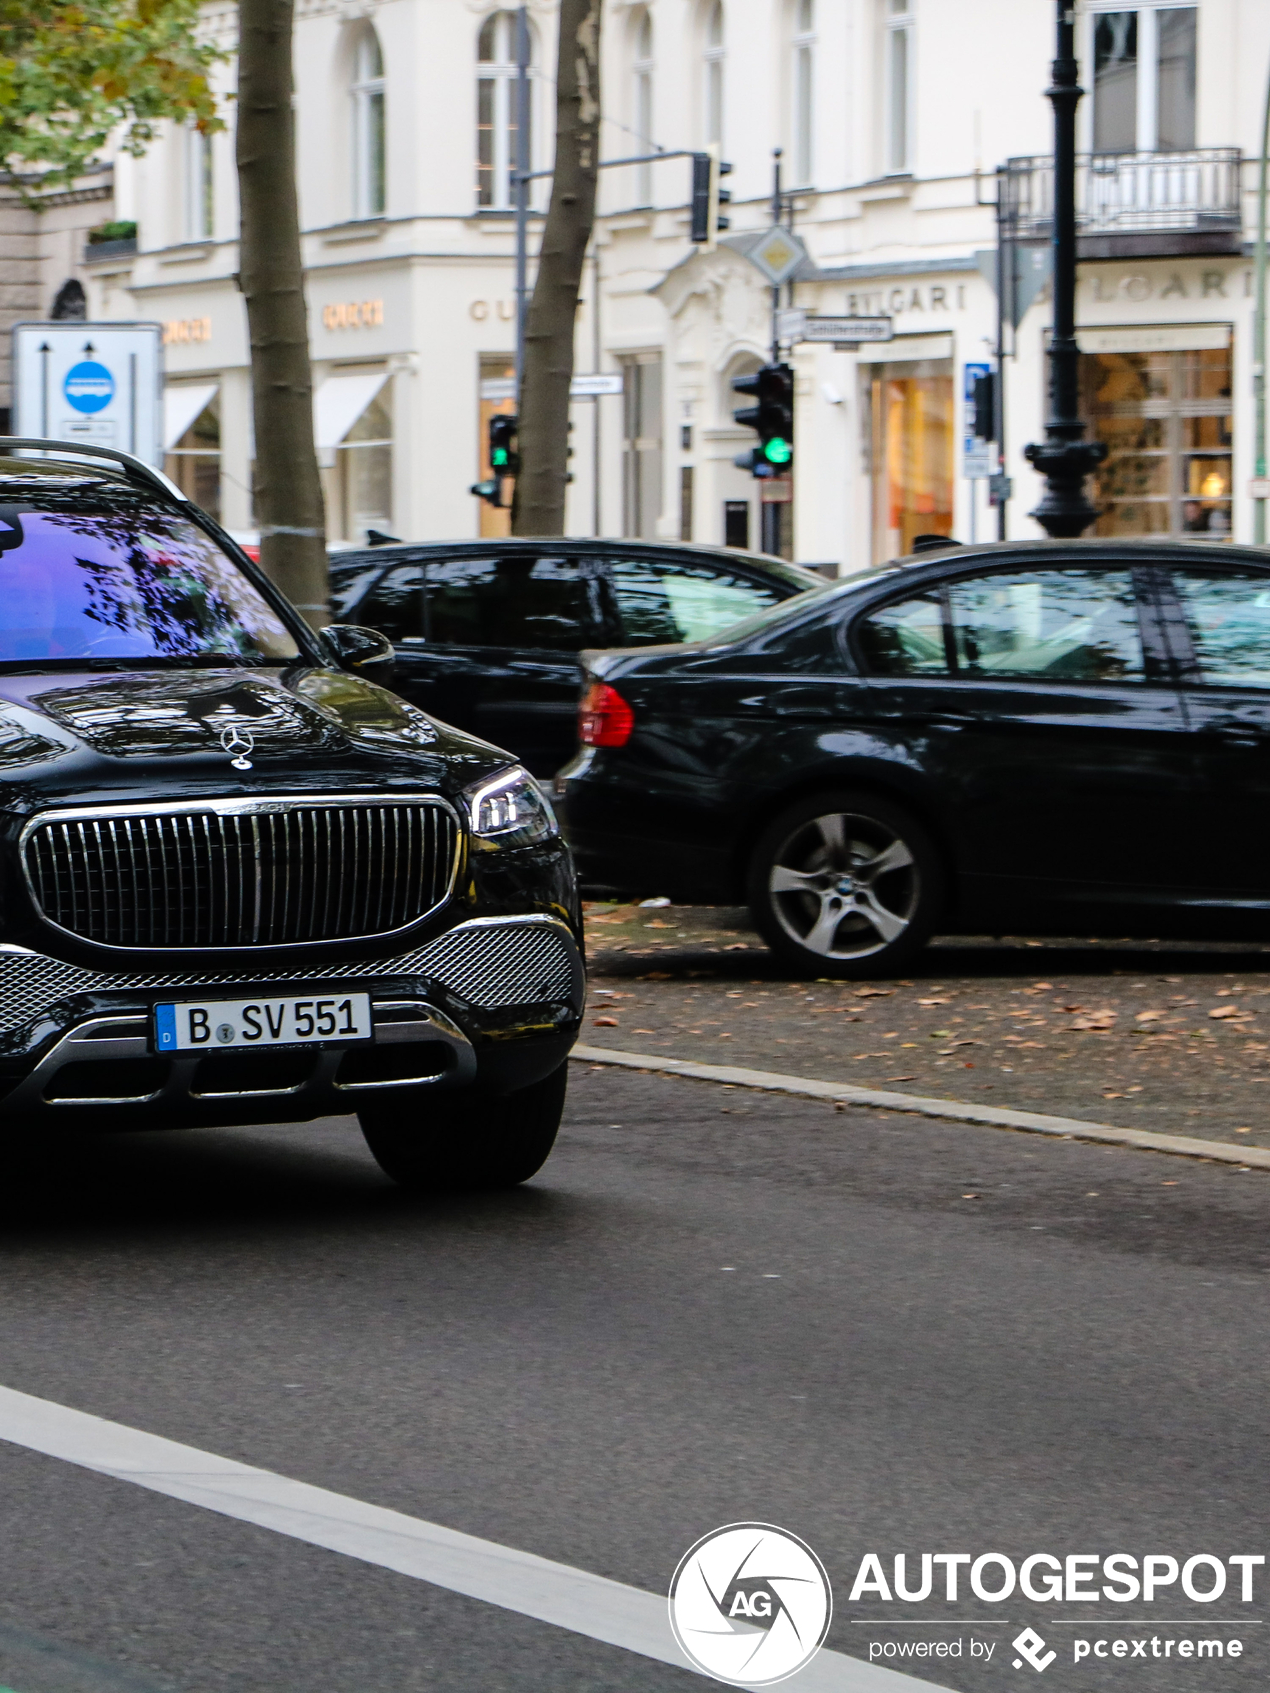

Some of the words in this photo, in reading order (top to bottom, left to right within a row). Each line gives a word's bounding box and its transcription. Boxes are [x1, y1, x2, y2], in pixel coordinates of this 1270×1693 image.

[324, 299, 384, 330] GUCCI
[188, 1008, 210, 1043] B
[242, 1004, 284, 1040] SV
[295, 999, 358, 1037] 551
